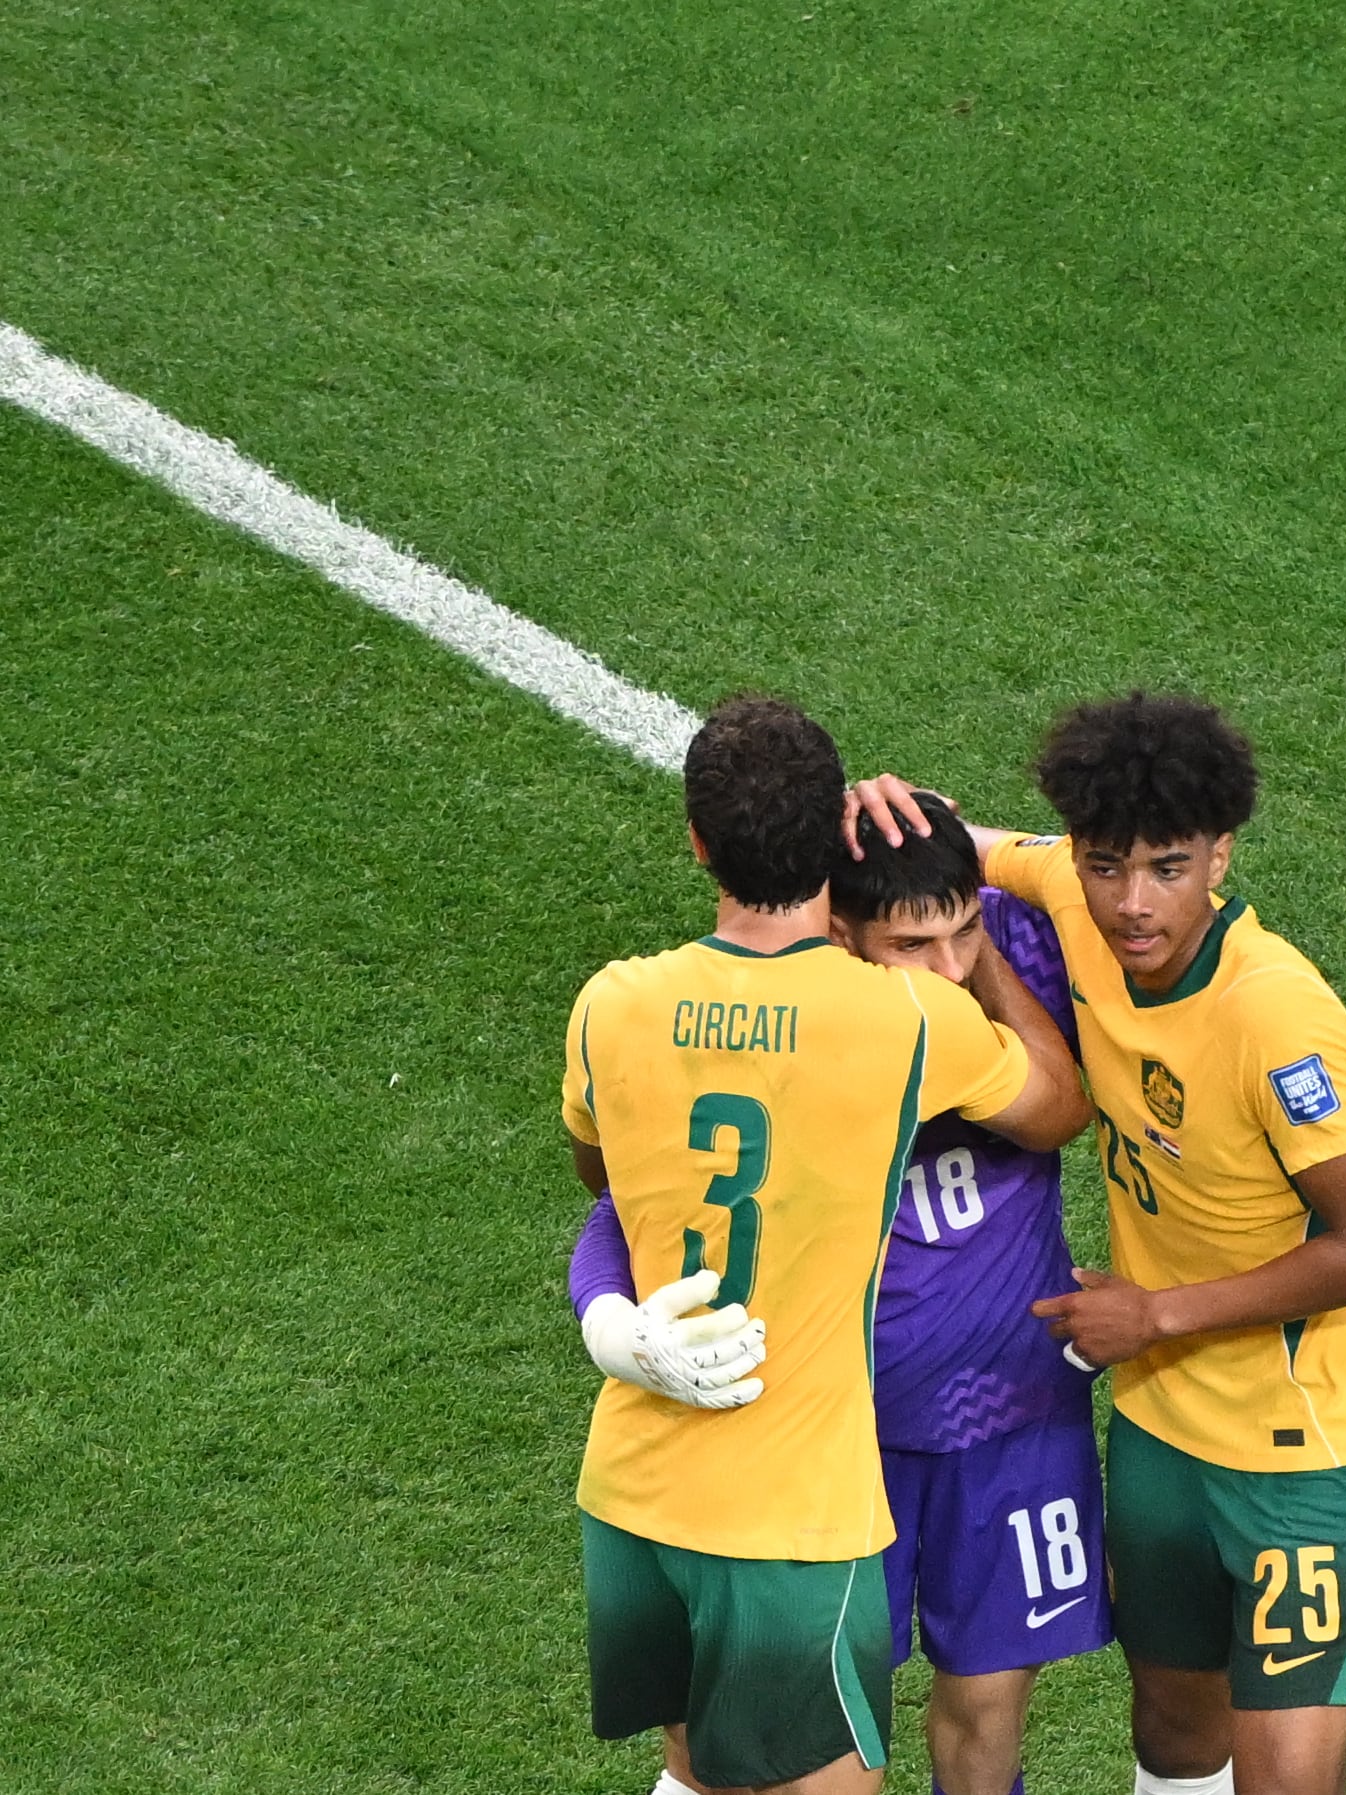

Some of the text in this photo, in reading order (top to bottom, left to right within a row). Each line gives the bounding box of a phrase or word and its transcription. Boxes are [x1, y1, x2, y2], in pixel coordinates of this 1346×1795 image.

[672, 1000, 799, 1053] CIRCATI
[1285, 1075, 1321, 1098] UNITES
[681, 1092, 772, 1309] 3
[905, 1147, 985, 1244] 18
[1097, 1107, 1159, 1216] 25
[1007, 1497, 1088, 1598] 18
[1252, 1545, 1341, 1645] 25
